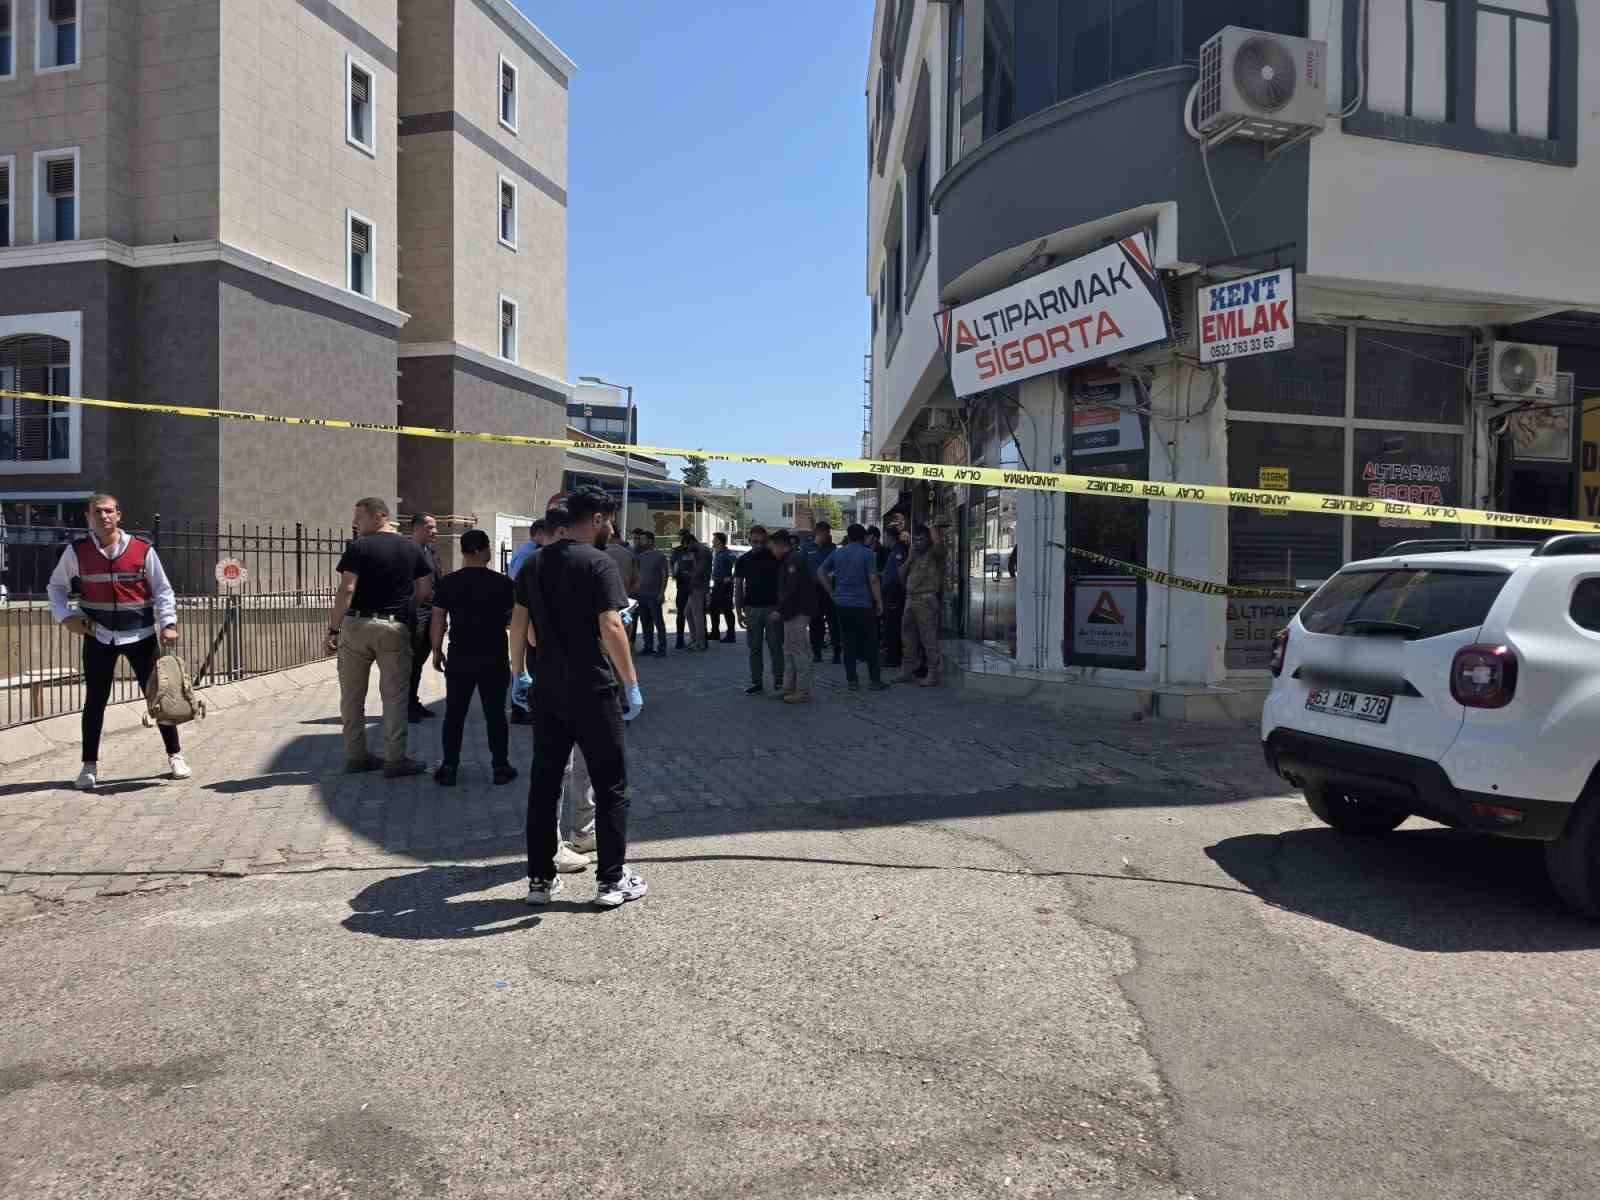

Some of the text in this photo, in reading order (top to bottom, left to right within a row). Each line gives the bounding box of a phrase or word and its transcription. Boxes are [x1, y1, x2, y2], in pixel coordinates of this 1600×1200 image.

[1209, 274, 1281, 312] KENT
[955, 261, 1133, 354] ALTIPARMAK
[1202, 299, 1290, 344] EMLAK
[974, 308, 1125, 381] SİGORTA
[1250, 338, 1261, 351] 33
[1263, 336, 1275, 349] 65
[953, 469, 981, 481] OLAY
[1003, 473, 1060, 487] JANDARMA
[1362, 462, 1451, 482] ALTIPARMAK
[1176, 488, 1205, 500] OLAY
[1229, 490, 1291, 505] JANDARMA
[1423, 506, 1457, 518] OLAY
[1226, 602, 1299, 620] ALTIPAR
[1315, 688, 1387, 716] 63 ABM 378
